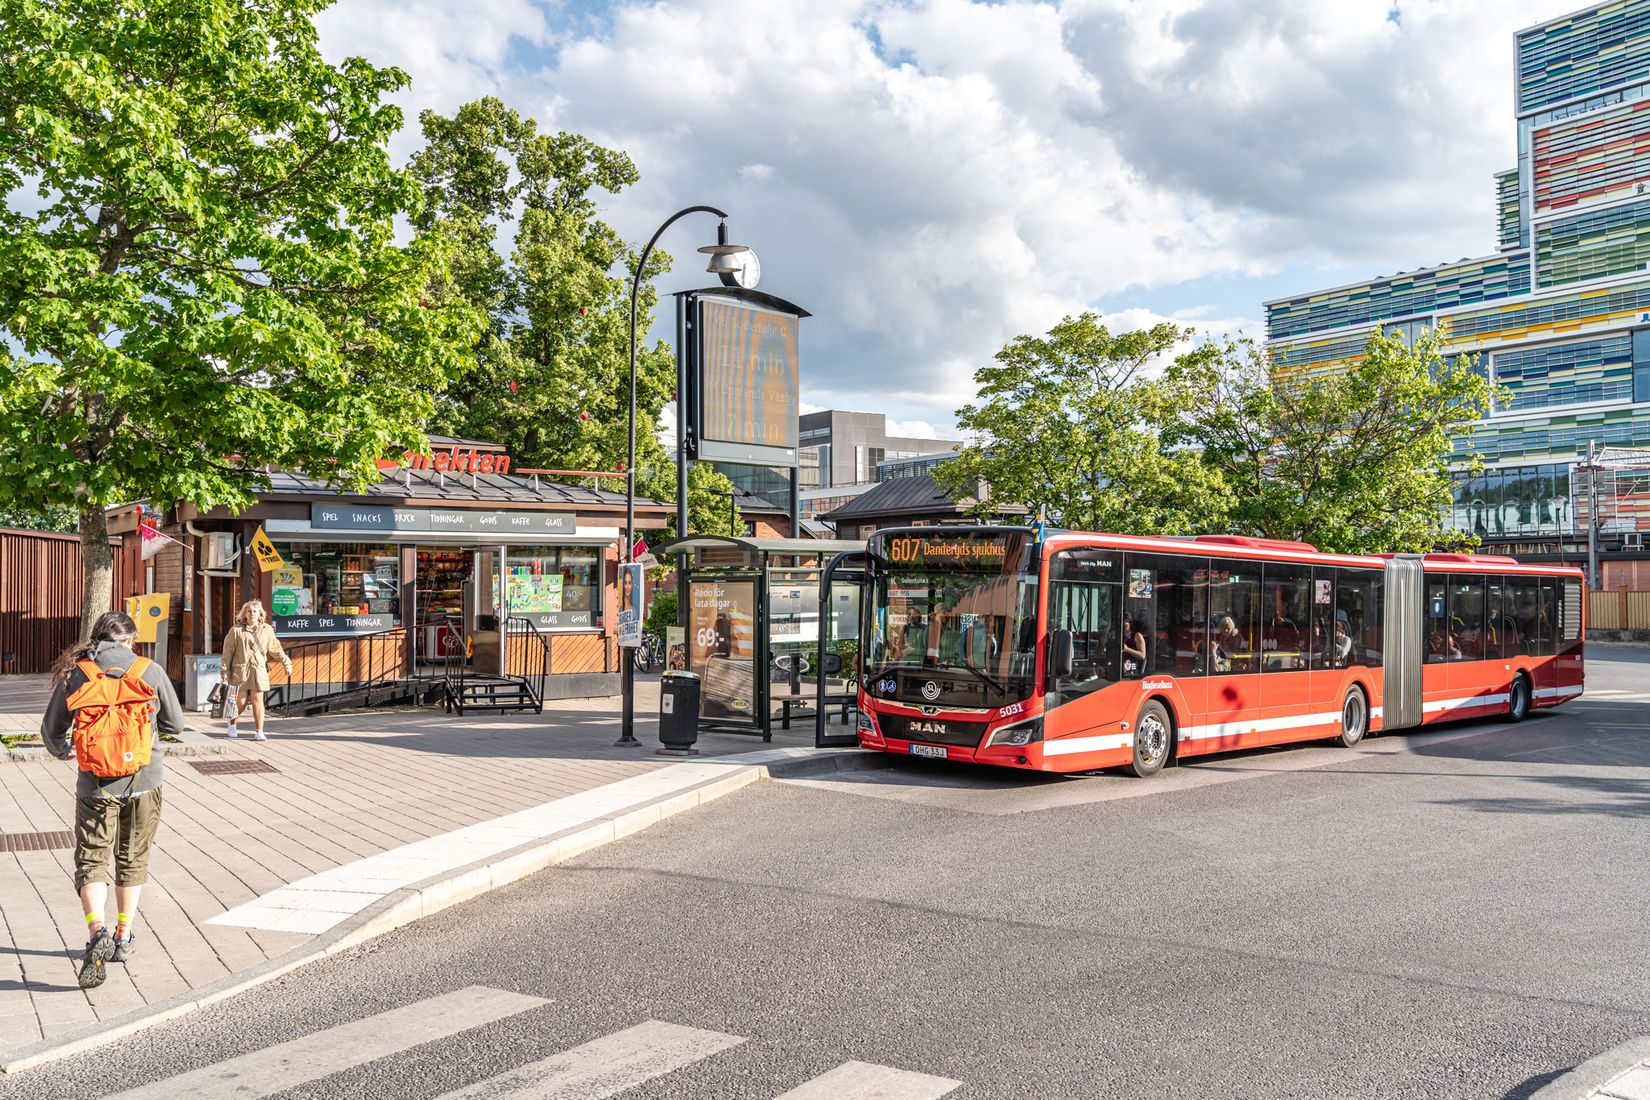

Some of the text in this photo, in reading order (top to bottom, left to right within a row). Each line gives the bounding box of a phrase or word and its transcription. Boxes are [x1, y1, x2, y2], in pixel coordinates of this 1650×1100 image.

[322, 511, 563, 527] SPEL SNACKS DRYCK TIDNINGAR GODIS KAFFE GLASS
[891, 538, 1006, 561] 607 Danderyds sjukhus
[694, 588, 725, 598] Redo för
[694, 598, 732, 610] lata dagar
[287, 618, 382, 628] KAFFE SPEL TIDNINGAR
[540, 615, 558, 625] GLASS
[571, 614, 588, 624] GODIS
[697, 627, 725, 648] 69:-
[1142, 680, 1173, 690] Biodieselbuss
[999, 703, 1024, 718] 5031
[910, 721, 946, 734] MAN
[915, 745, 945, 757] OHG 33J
